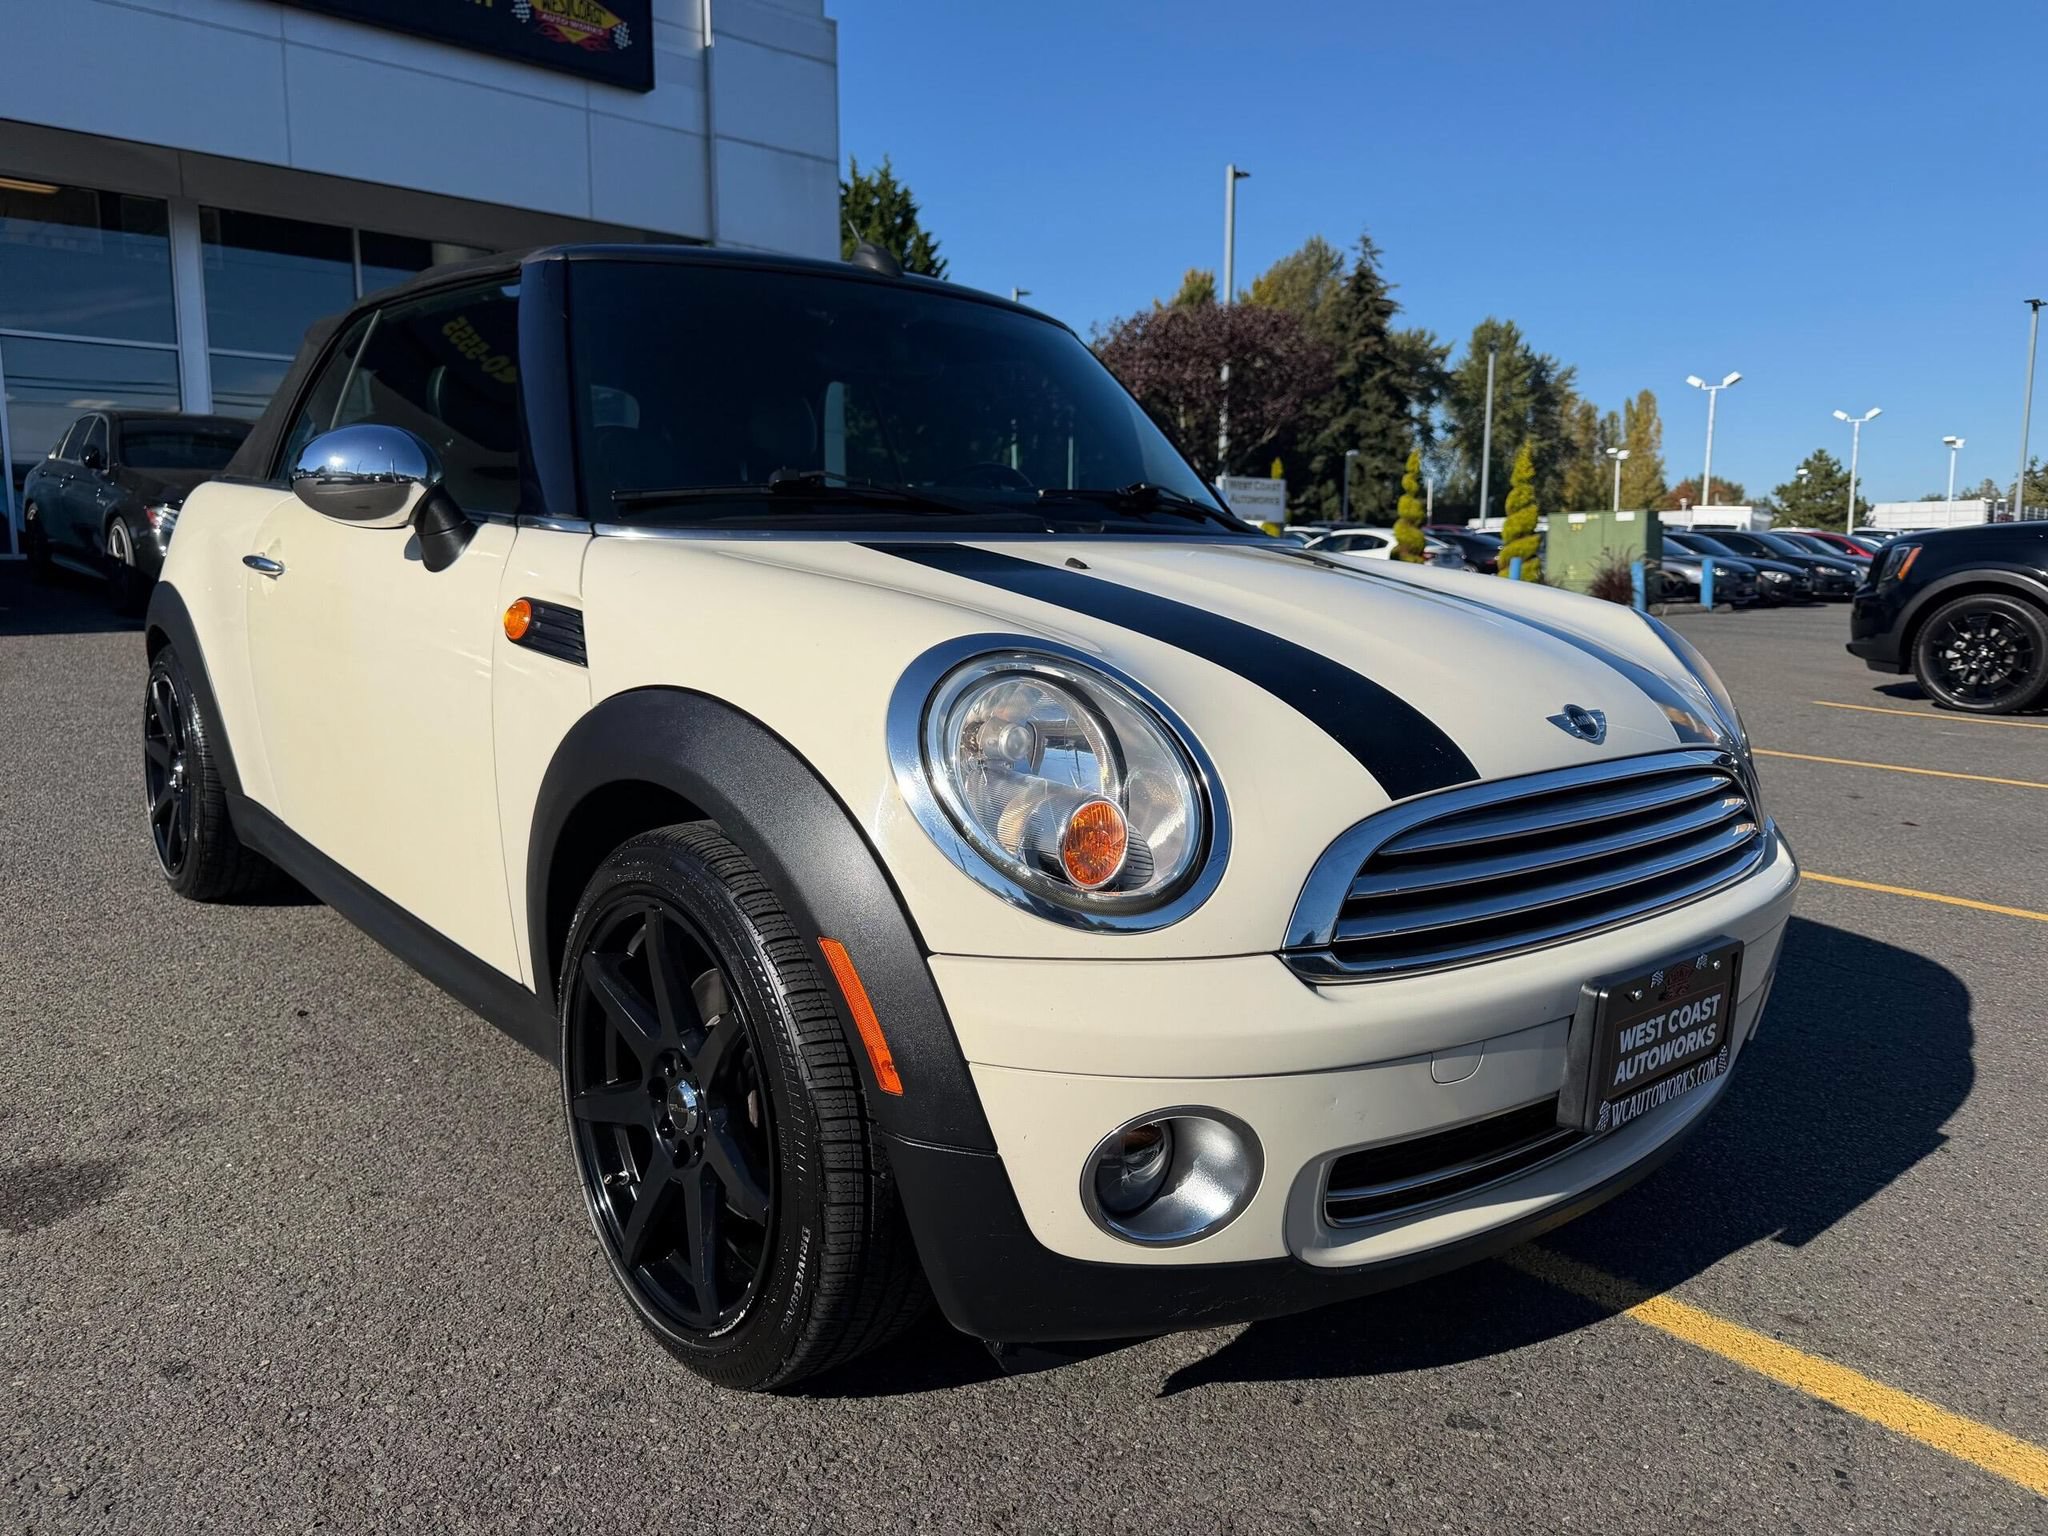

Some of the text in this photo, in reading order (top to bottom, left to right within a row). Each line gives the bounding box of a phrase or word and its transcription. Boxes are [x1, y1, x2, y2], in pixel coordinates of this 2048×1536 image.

[1613, 1023, 1717, 1087] AUTOWORKS
[1619, 993, 1721, 1053] WEST COAST
[1611, 1056, 1718, 1127] WCAUTOWORKS.COM
